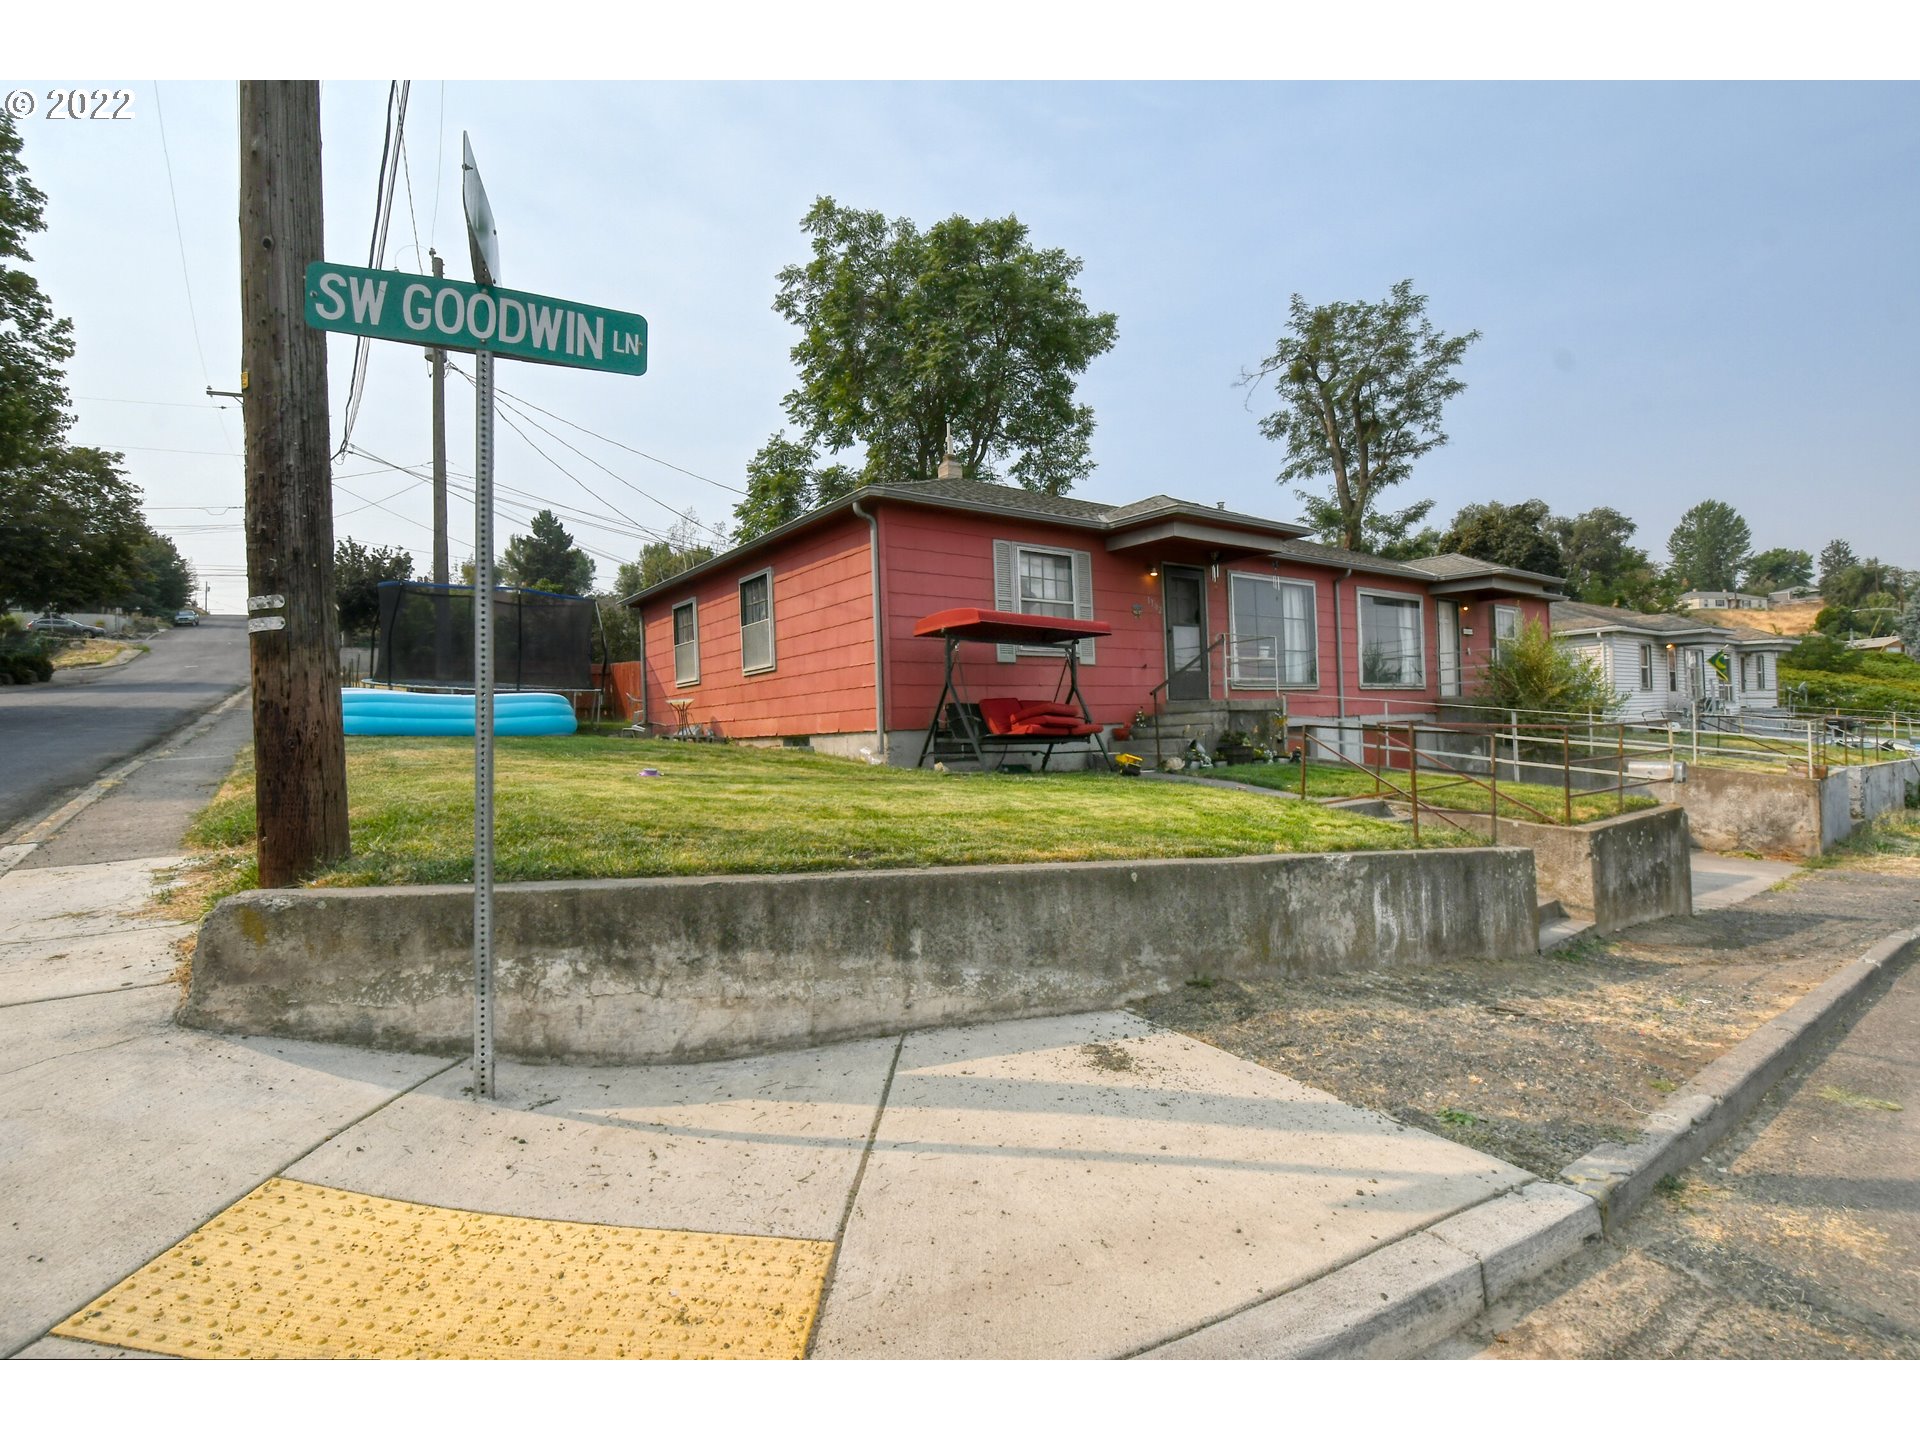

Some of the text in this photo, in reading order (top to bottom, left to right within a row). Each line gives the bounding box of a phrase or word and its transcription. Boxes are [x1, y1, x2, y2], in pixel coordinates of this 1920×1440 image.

[315, 273, 640, 360] SW GOODWIN LN
